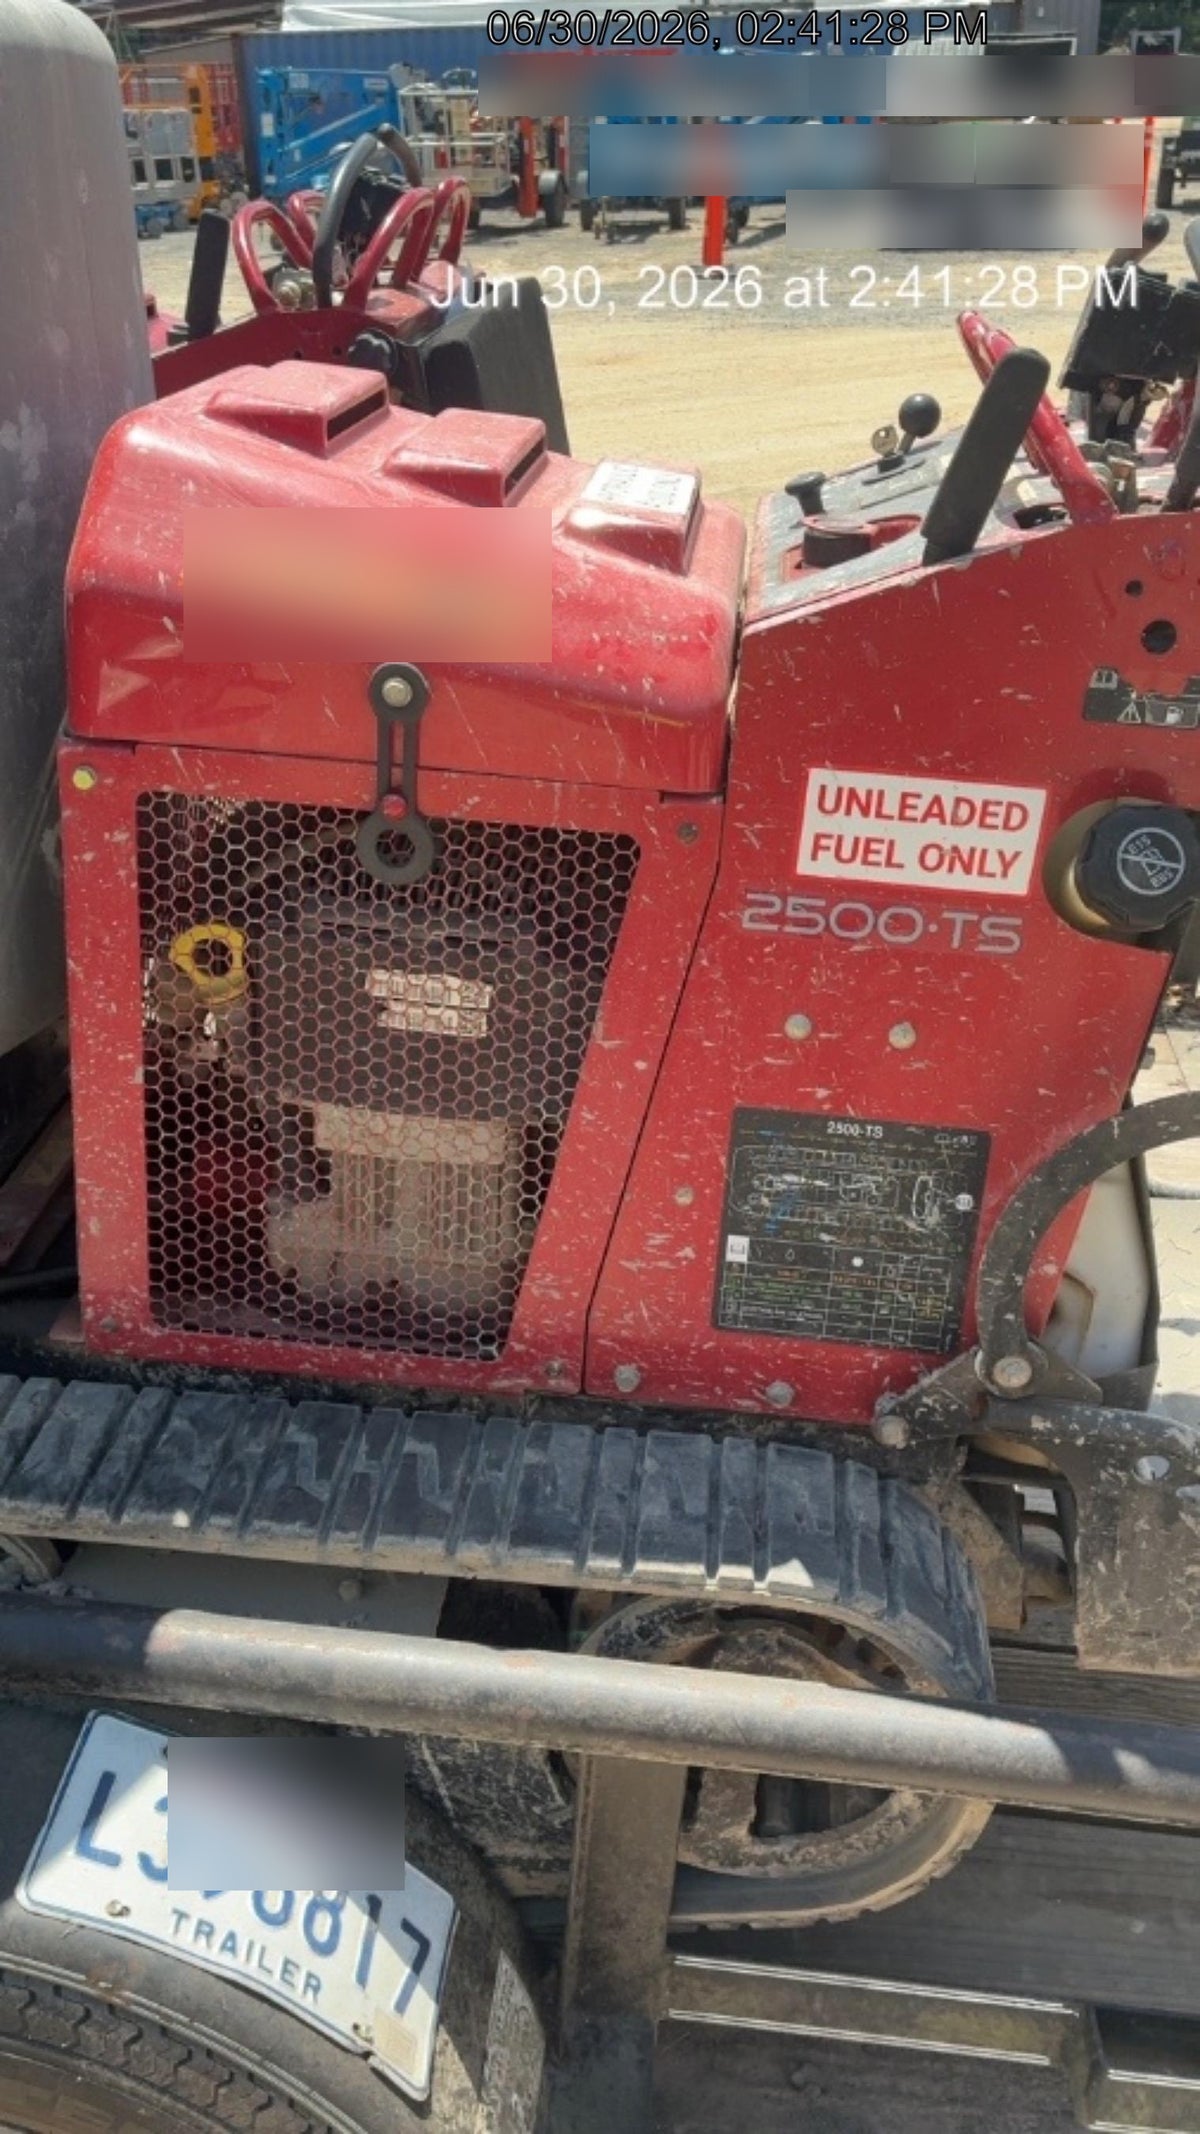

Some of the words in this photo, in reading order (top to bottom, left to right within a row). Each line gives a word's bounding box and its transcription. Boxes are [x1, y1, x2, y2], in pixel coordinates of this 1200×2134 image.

[816, 783, 1030, 832] UNLEADED
[810, 832, 905, 869] FUEL
[918, 842, 1022, 879] ONLY
[170, 1907, 324, 2005] TRAILER
